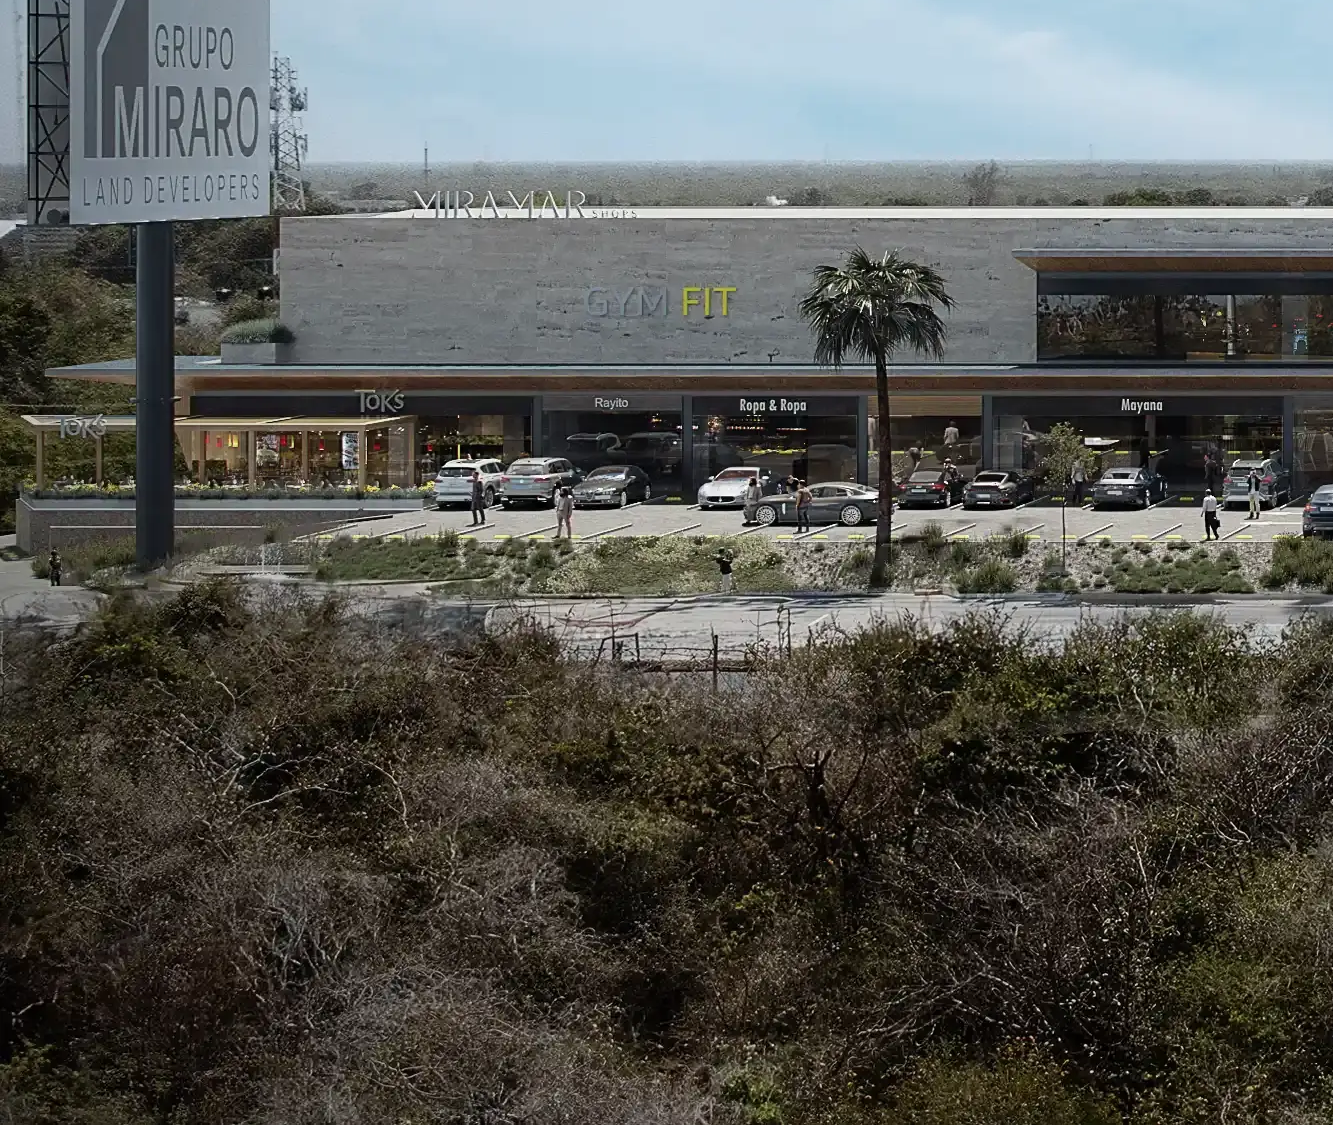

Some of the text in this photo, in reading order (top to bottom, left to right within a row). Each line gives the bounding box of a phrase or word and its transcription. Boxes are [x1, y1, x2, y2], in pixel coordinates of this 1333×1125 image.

[155, 24, 234, 70] GRUPO
[114, 85, 259, 158] MIRARO
[83, 174, 259, 206] LAND DEVELOPERS
[412, 190, 638, 219] MIRAMAR SHOPS
[586, 286, 737, 316] GYM FIT
[594, 397, 629, 410] Rayito
[739, 398, 807, 414] Ropa & Ropa
[1121, 398, 1163, 415] Mayana
